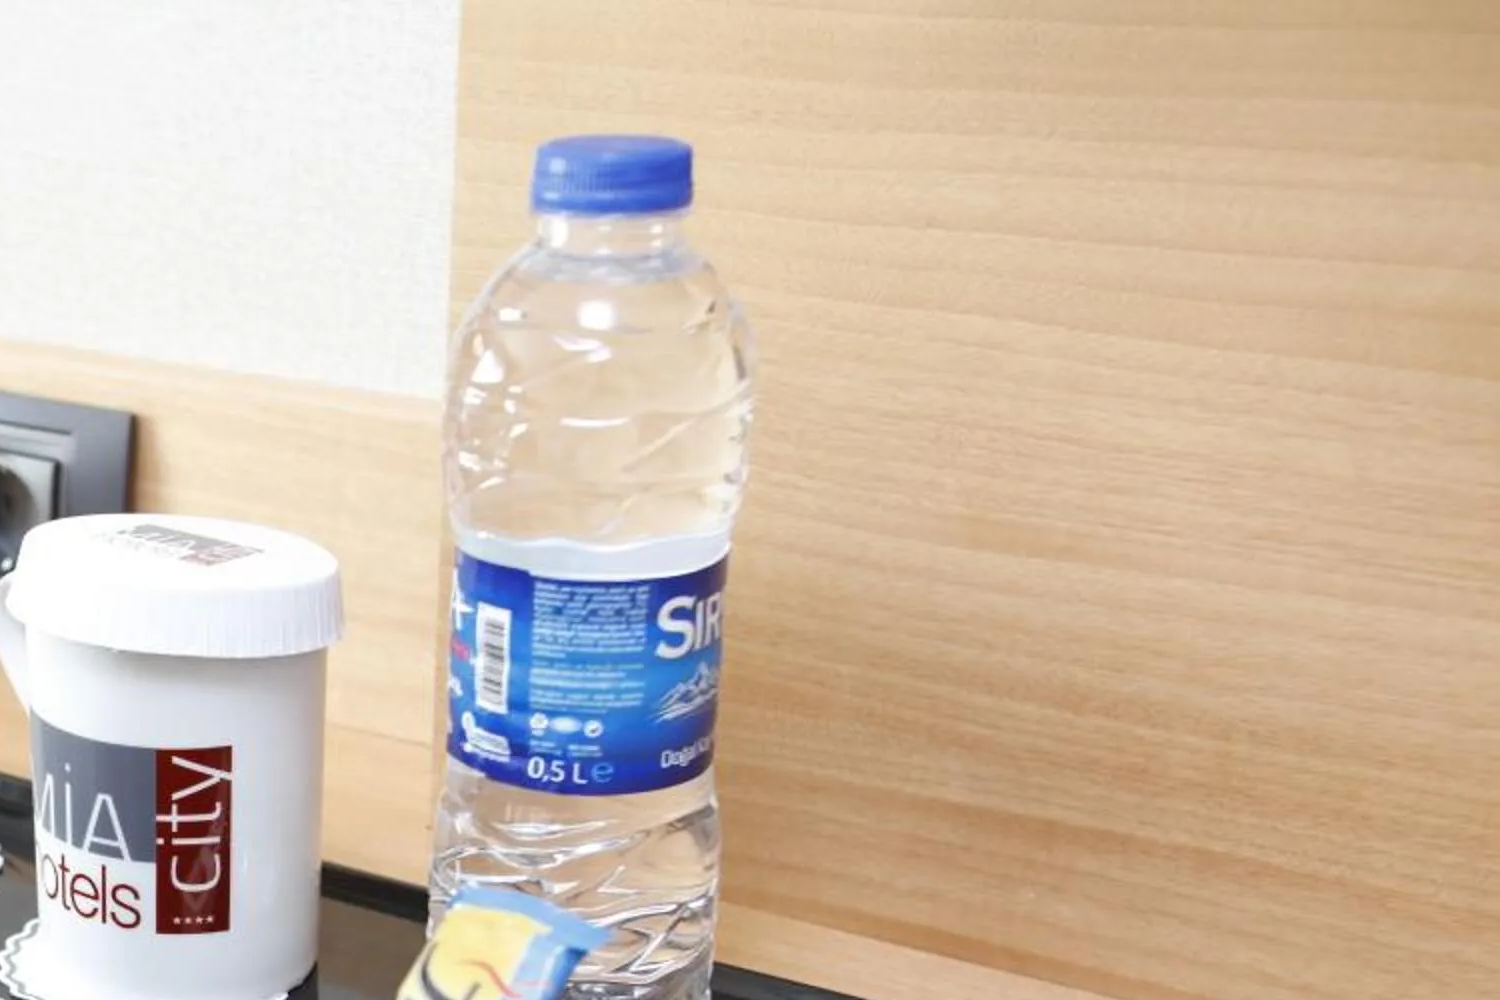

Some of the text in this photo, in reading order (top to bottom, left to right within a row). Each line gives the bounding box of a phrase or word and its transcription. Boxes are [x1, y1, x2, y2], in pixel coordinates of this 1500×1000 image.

[527, 755, 565, 783] 0,5
[572, 763, 589, 784] L
[156, 755, 233, 892] city
